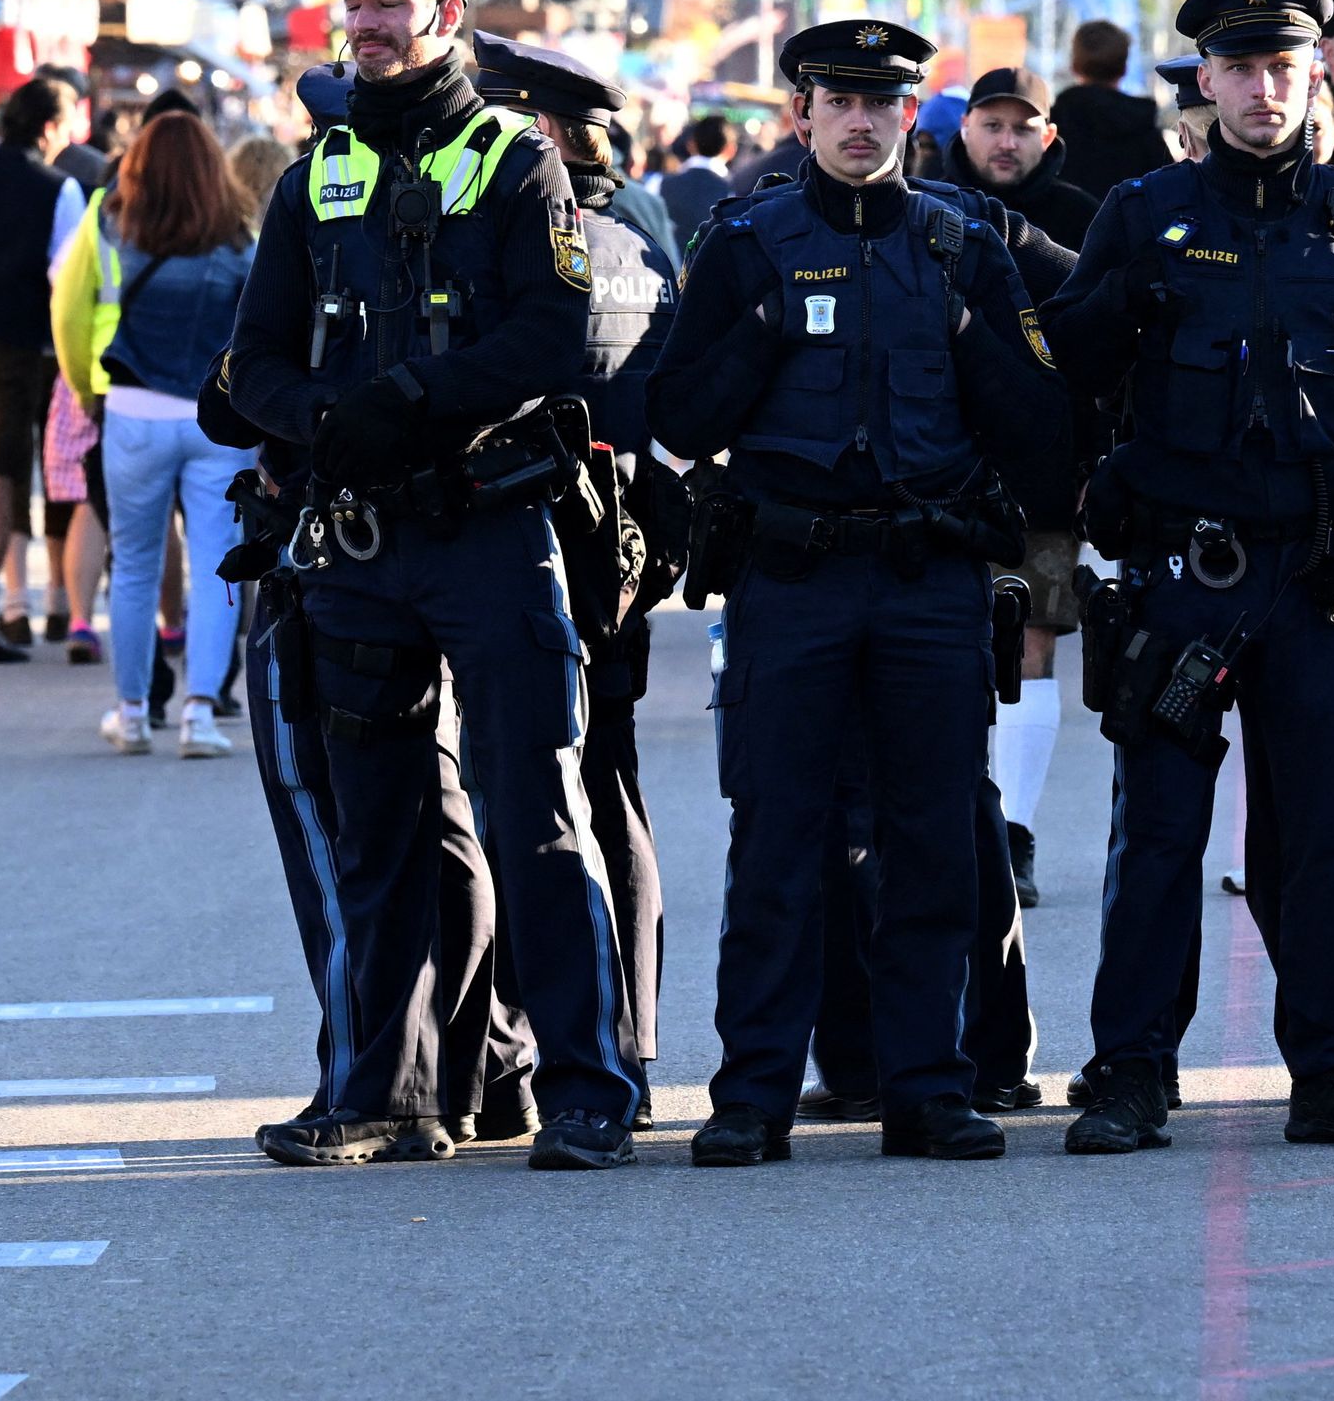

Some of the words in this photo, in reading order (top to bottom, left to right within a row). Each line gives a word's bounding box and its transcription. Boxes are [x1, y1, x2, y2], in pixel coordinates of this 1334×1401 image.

[321, 185, 359, 200] POLIZEI
[1186, 248, 1239, 264] POLIZEI
[794, 267, 847, 281] POLIZEI
[593, 275, 674, 304] POLIZEI
